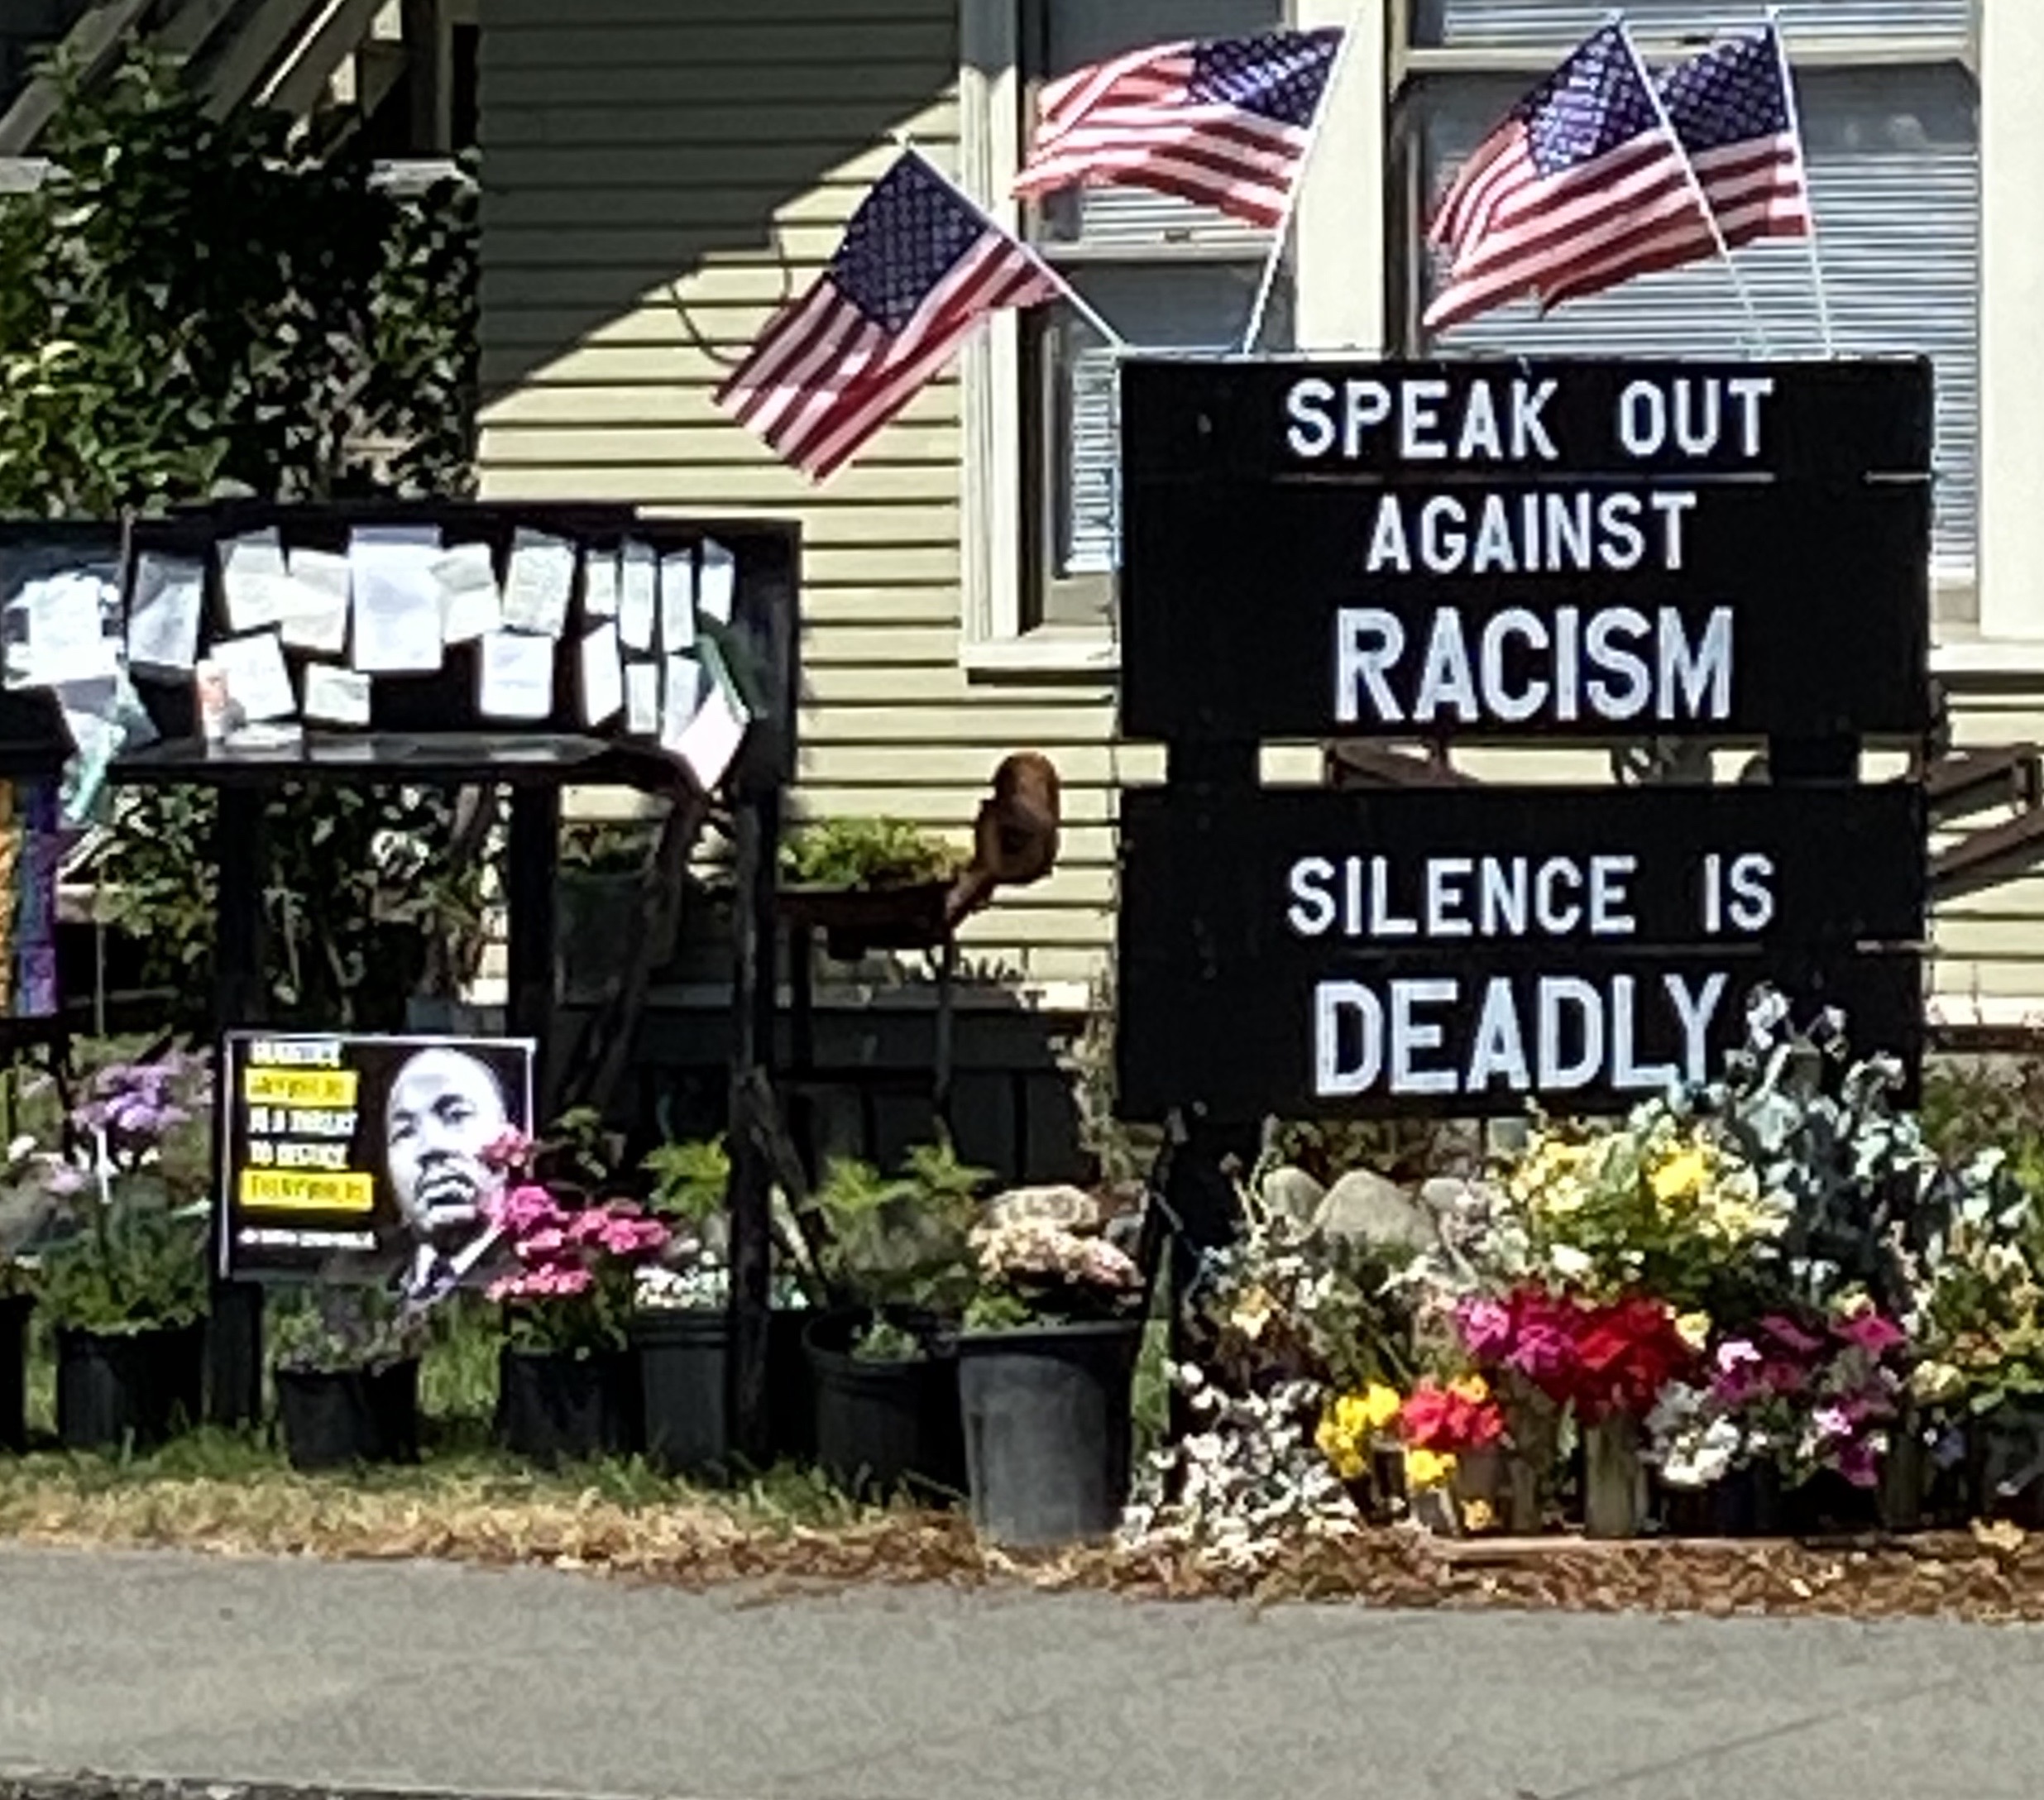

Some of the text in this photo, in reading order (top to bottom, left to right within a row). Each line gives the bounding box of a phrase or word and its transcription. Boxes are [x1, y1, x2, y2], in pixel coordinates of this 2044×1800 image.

[1286, 377, 1774, 460] SPEAK OUT
[1366, 491, 1697, 573] AGAINST
[1335, 606, 1733, 722] RACISM
[1288, 854, 1774, 936] SILENCE IS
[1315, 973, 1728, 1096] DEADLY
